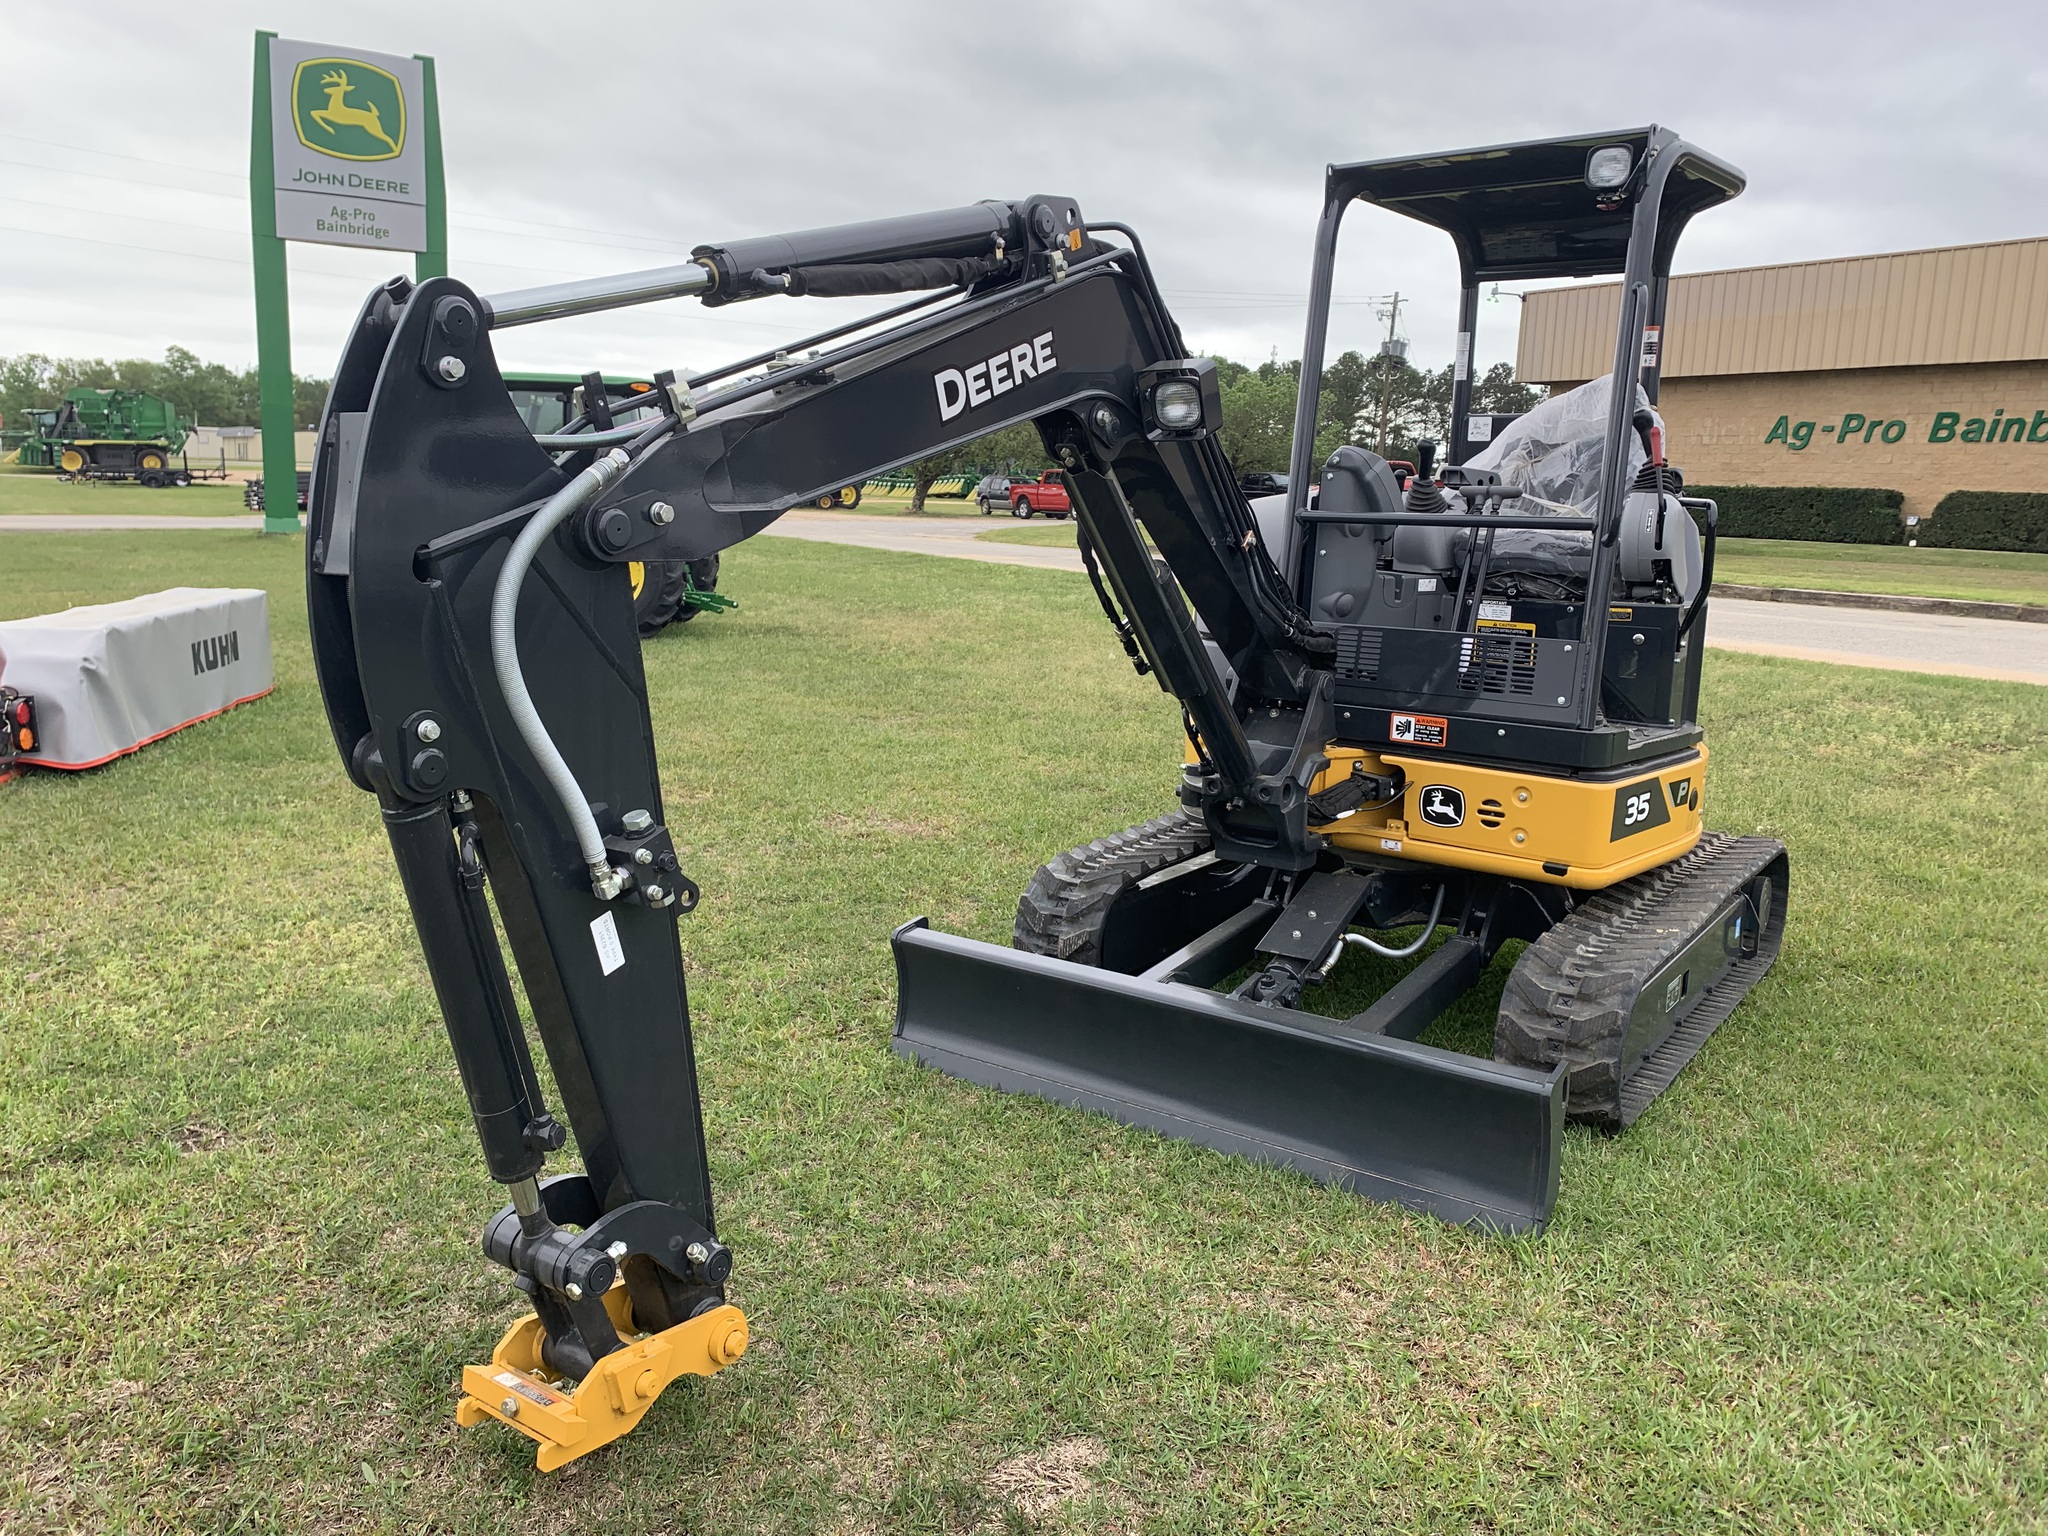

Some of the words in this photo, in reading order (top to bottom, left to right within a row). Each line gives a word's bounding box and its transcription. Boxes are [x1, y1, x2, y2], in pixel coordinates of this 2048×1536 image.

[292, 168, 344, 186] JOHN
[348, 173, 410, 194] DEERE
[316, 219, 390, 240] Bainbridge
[330, 206, 376, 222] Ag-Pro
[934, 331, 1057, 422] DEERE
[1764, 413, 1907, 450] Ag-Pro
[1928, 409, 2048, 443] Bainb
[191, 631, 240, 676] KUHN
[1420, 718, 1445, 726] WARNING
[1624, 792, 1651, 825] 35
[1676, 781, 1689, 804] P
